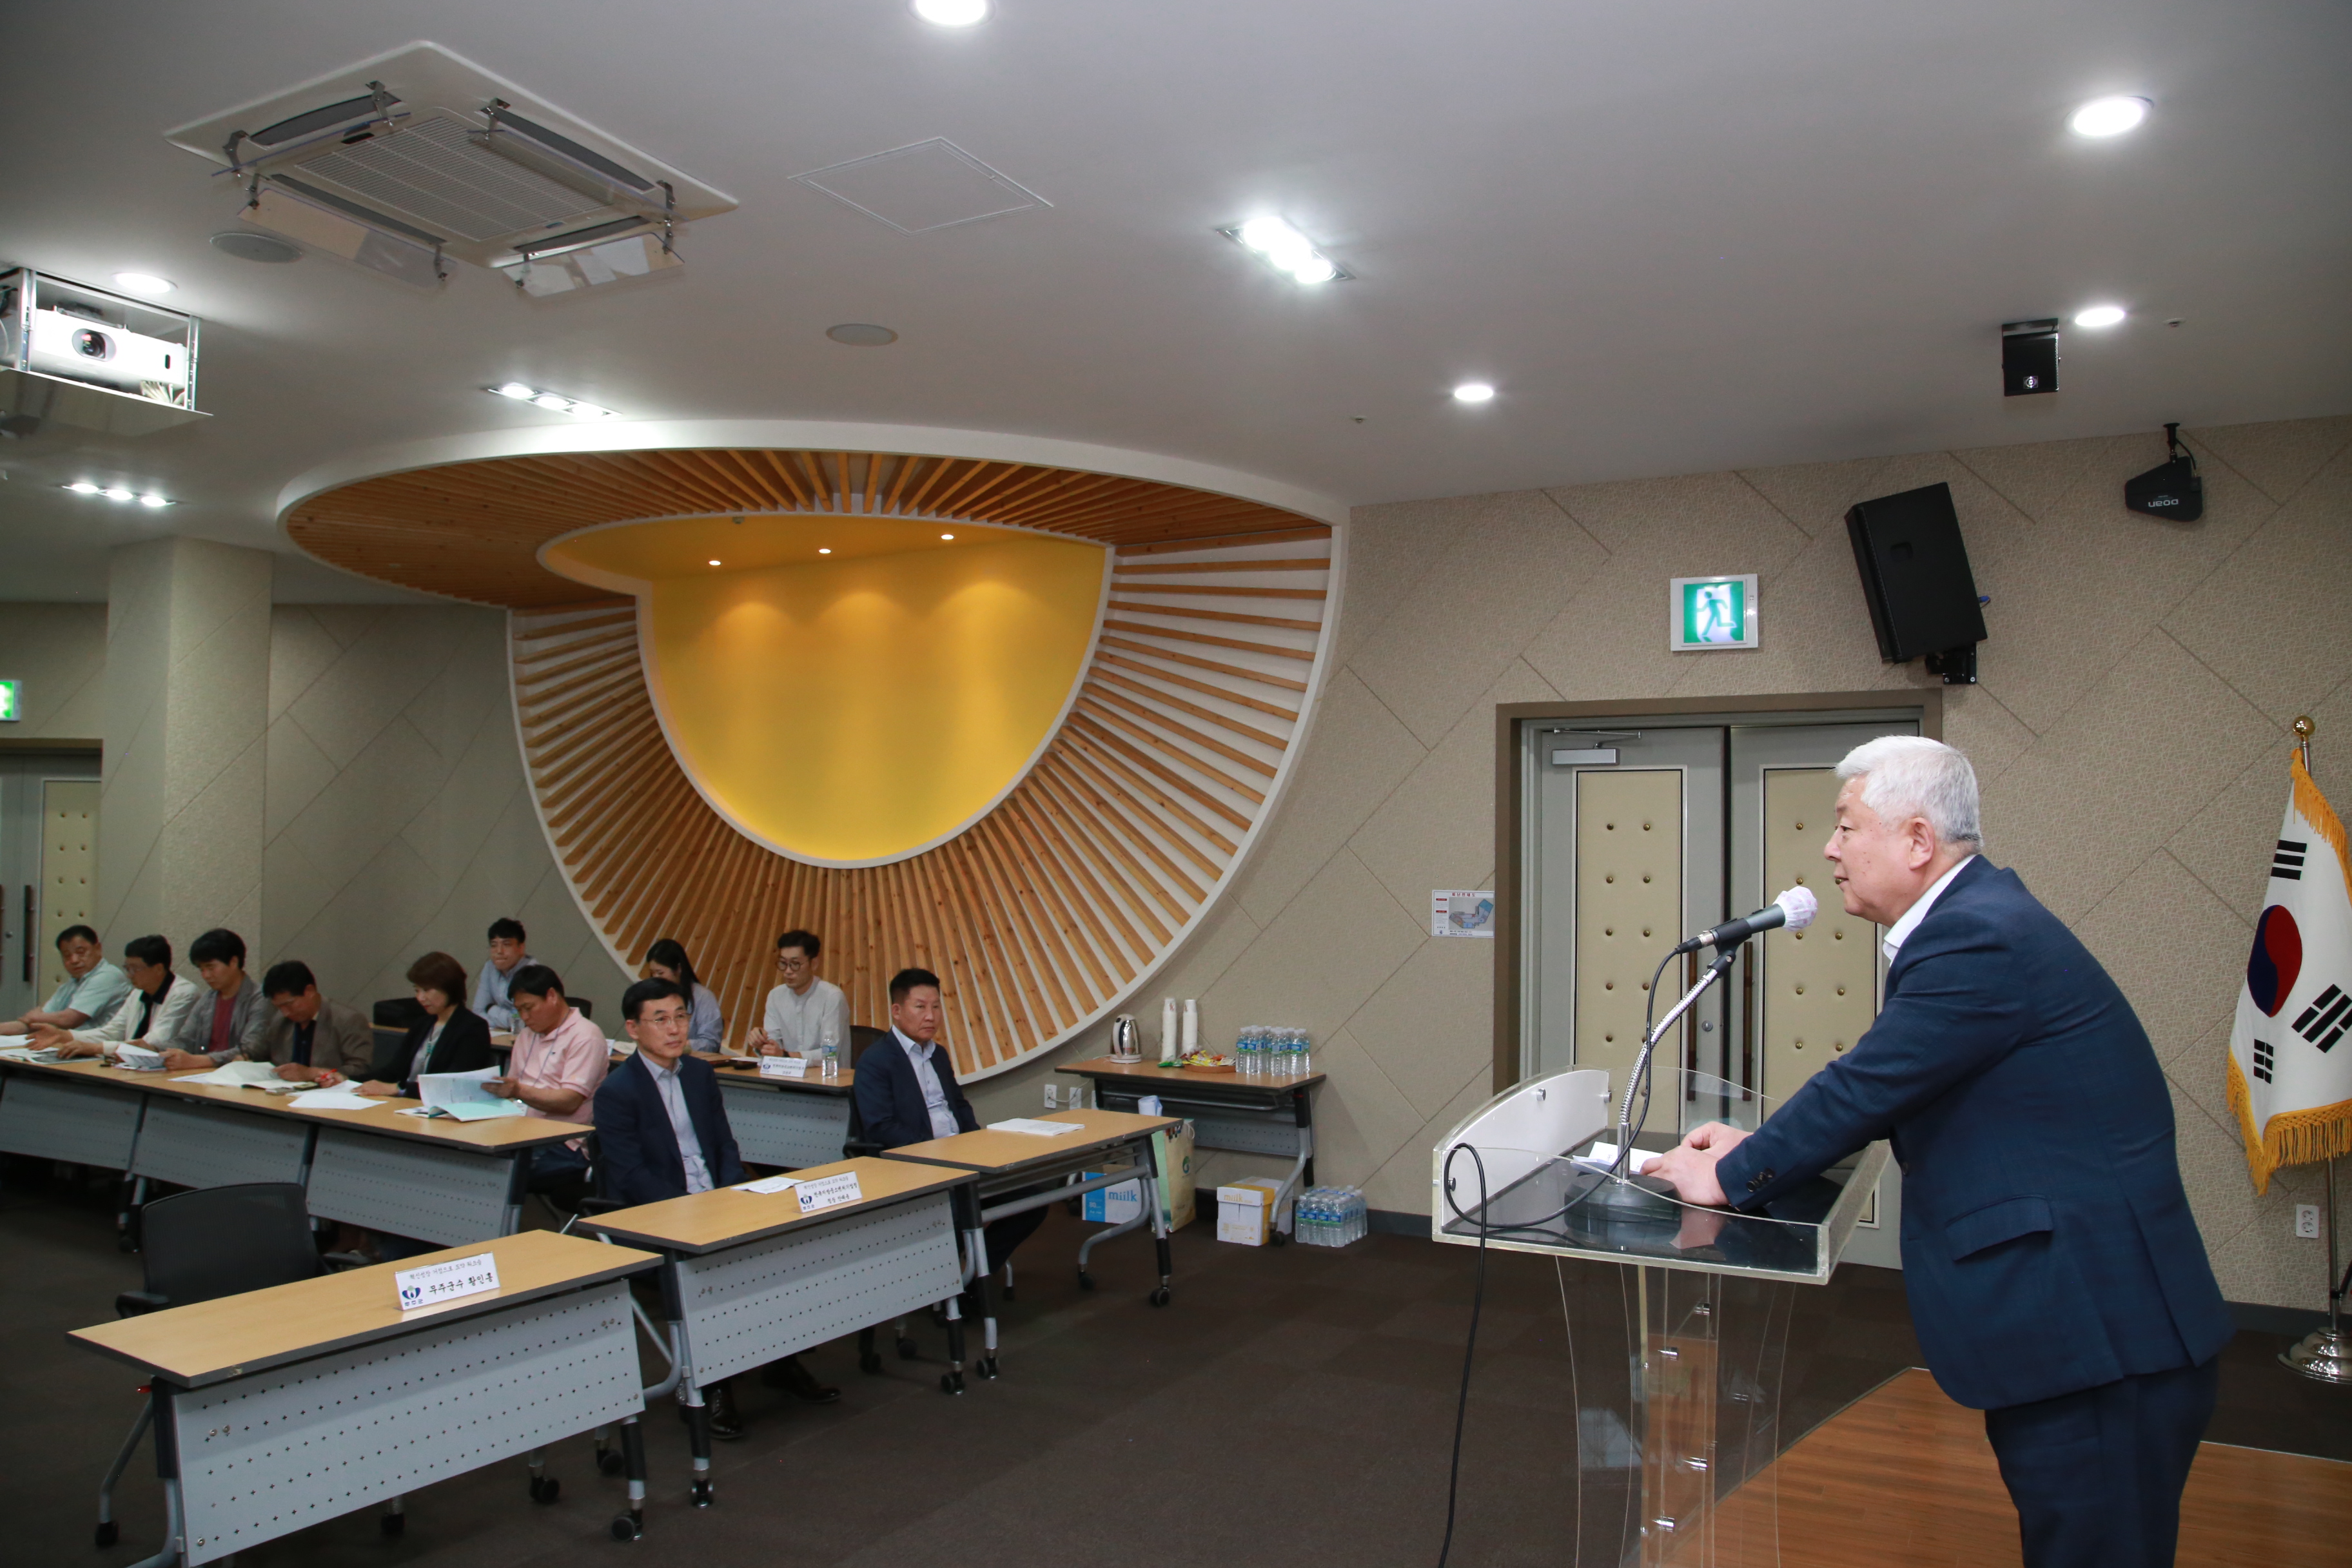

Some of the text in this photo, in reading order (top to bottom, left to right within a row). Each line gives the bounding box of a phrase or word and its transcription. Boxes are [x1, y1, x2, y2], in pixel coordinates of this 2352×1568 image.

[1108, 1190, 1137, 1202] miilk
[1224, 1193, 1243, 1202] miilk
[409, 1270, 431, 1280] 혁신성장
[433, 1266, 454, 1275] 거점으로
[429, 1279, 464, 1295] 무주군수
